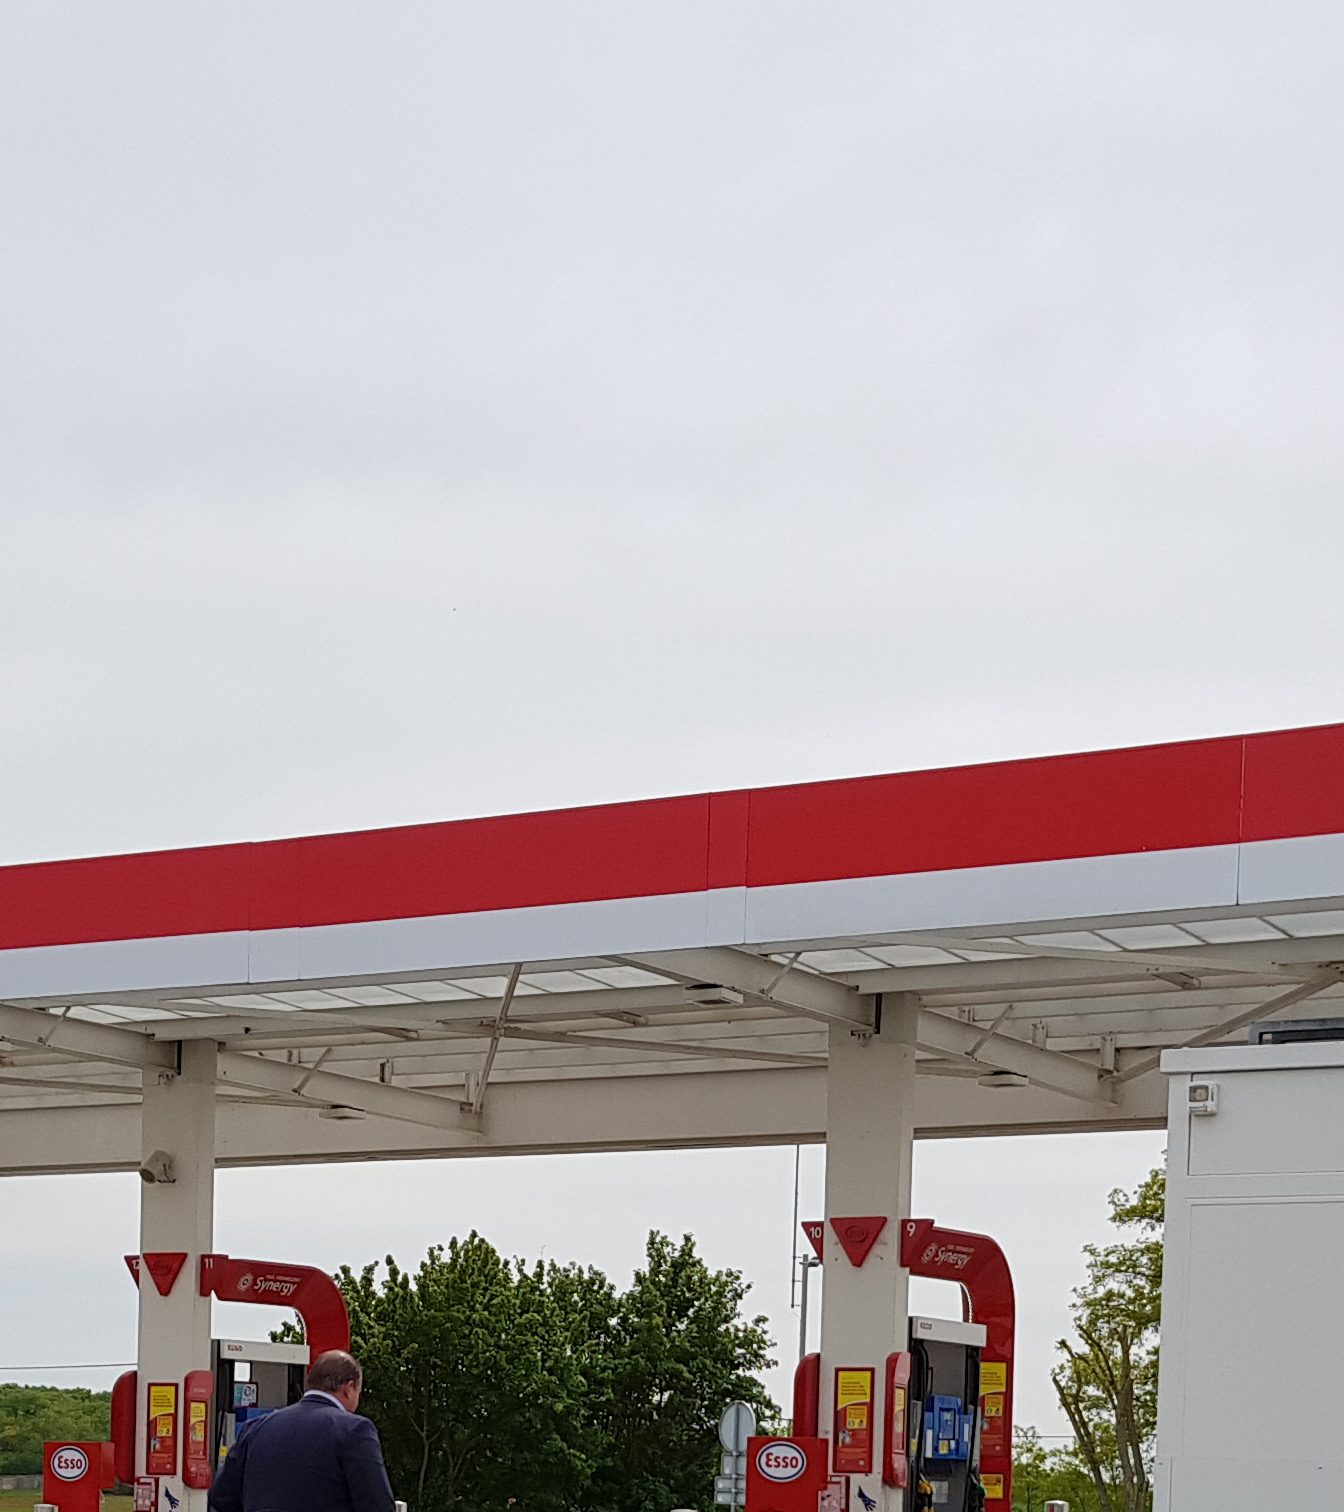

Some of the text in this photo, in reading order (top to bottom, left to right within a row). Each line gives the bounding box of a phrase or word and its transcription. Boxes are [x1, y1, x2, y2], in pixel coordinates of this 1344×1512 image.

[809, 1226, 822, 1239] 10
[906, 1221, 916, 1237] 9
[204, 1257, 213, 1269] 11
[934, 1246, 972, 1270] Synergy
[253, 1276, 298, 1297] Synergy
